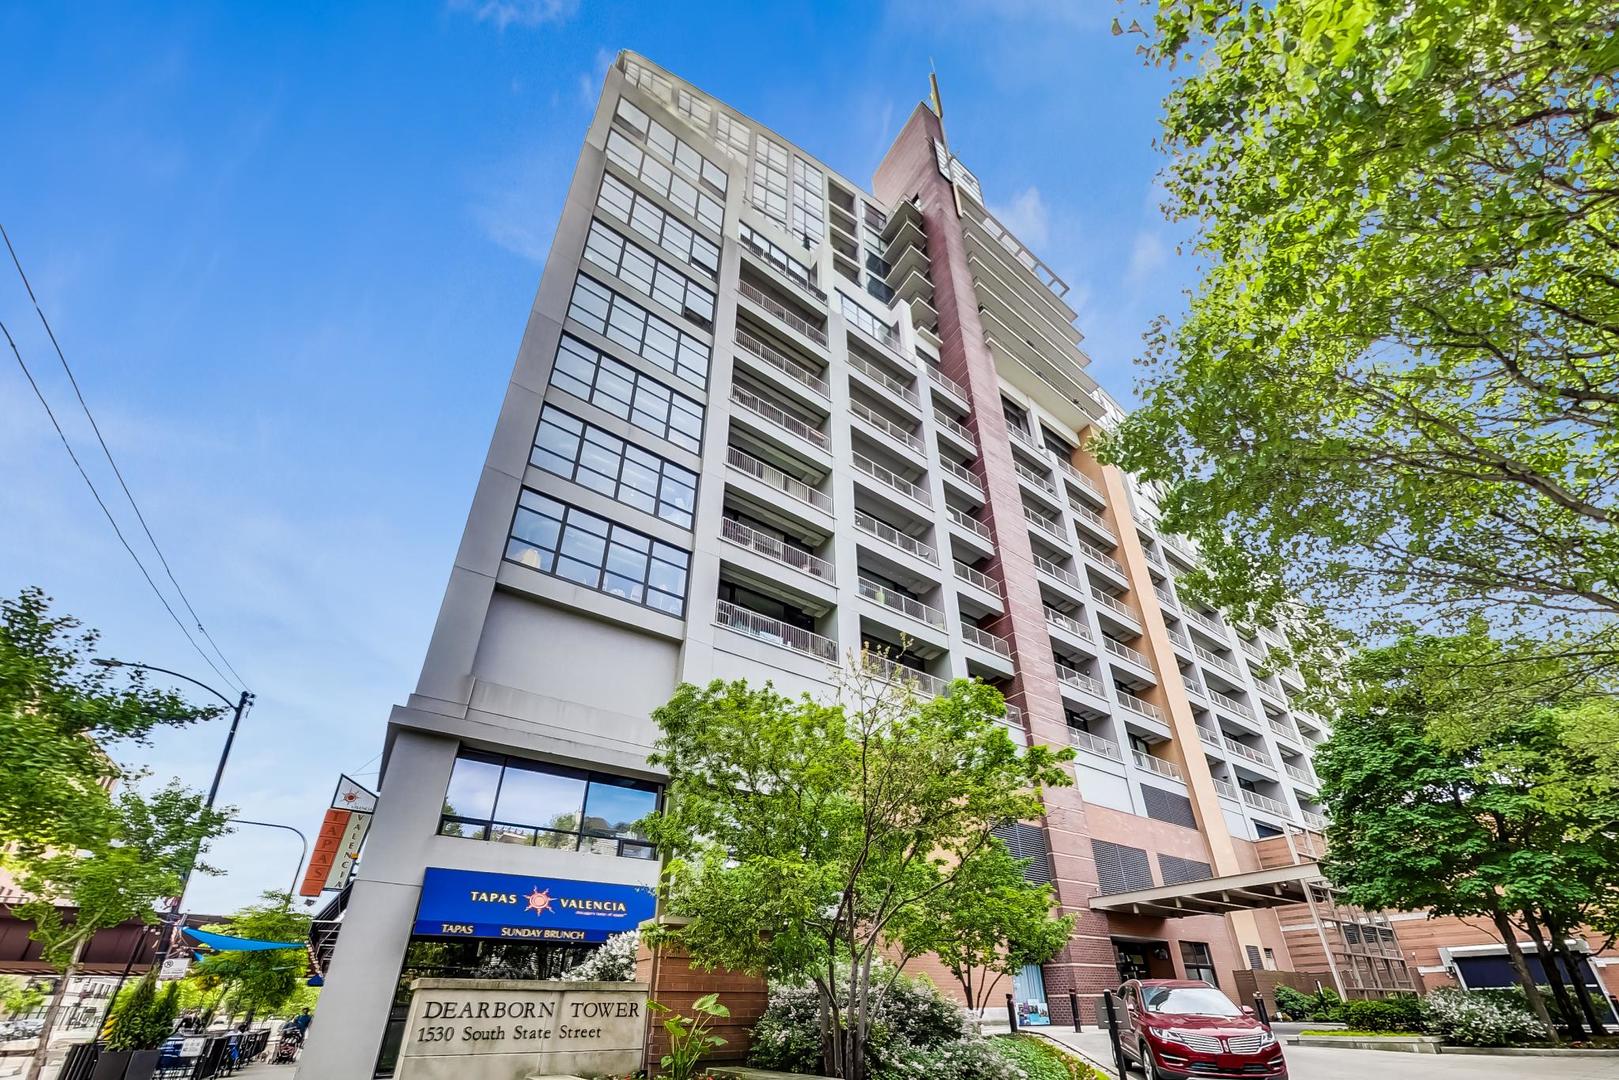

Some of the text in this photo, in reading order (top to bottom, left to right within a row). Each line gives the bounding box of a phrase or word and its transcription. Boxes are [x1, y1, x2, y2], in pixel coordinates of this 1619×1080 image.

[314, 811, 341, 877] TAPAS
[335, 814, 365, 888] VALENCIA
[470, 891, 626, 912] TAPAS VALENCIA
[441, 924, 474, 935] TAPAS
[501, 927, 585, 940] SUNDAY BRUNCH
[422, 1001, 640, 1019] DEARBORN TOWER
[417, 1024, 602, 1042] 1530 South State Street
